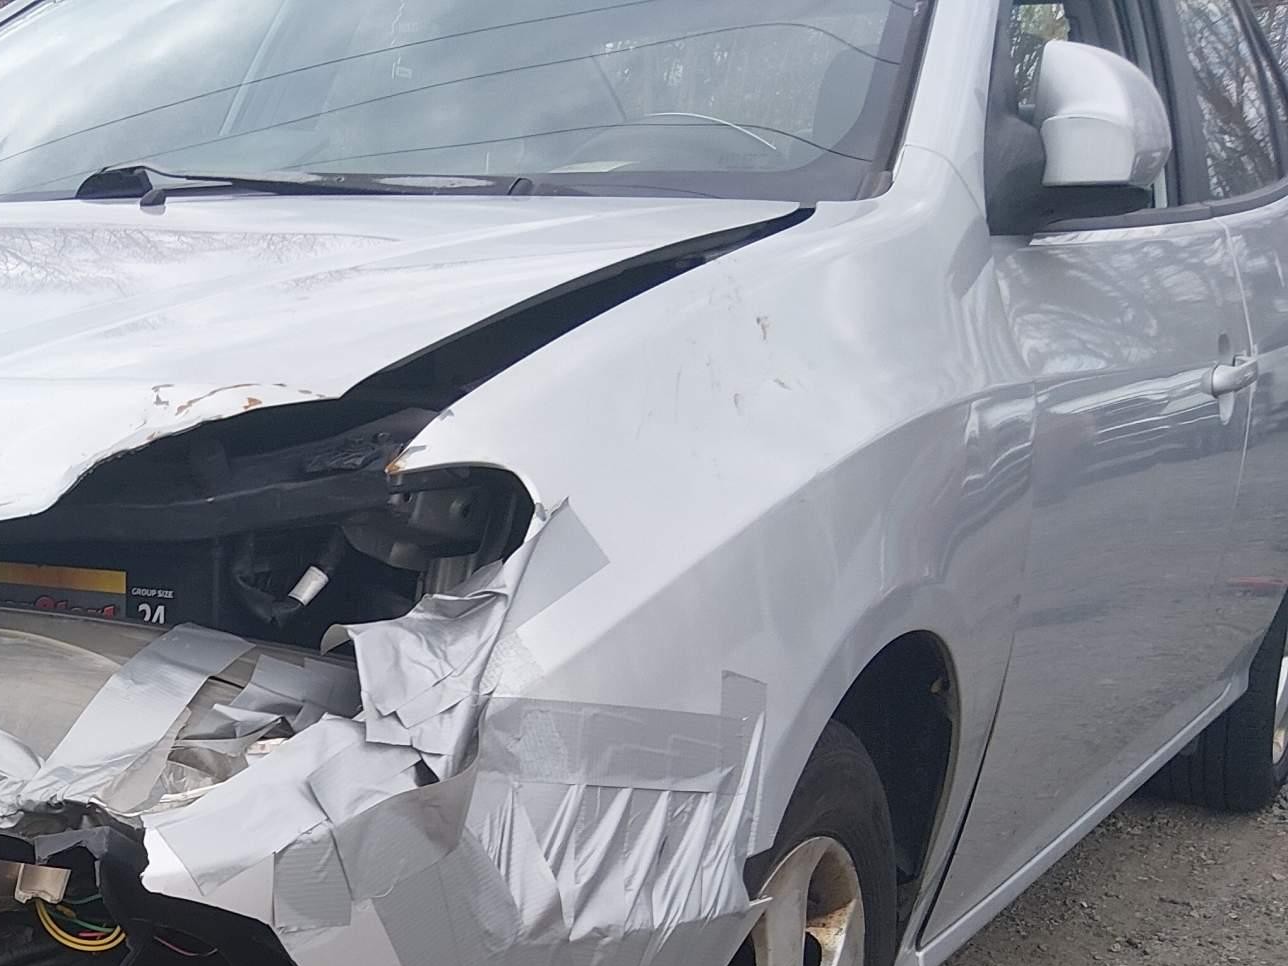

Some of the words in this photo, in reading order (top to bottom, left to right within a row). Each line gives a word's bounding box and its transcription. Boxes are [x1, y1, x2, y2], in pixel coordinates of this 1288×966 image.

[132, 587, 156, 597] GROUP
[157, 589, 174, 599] SIZE
[138, 603, 165, 624] 24
